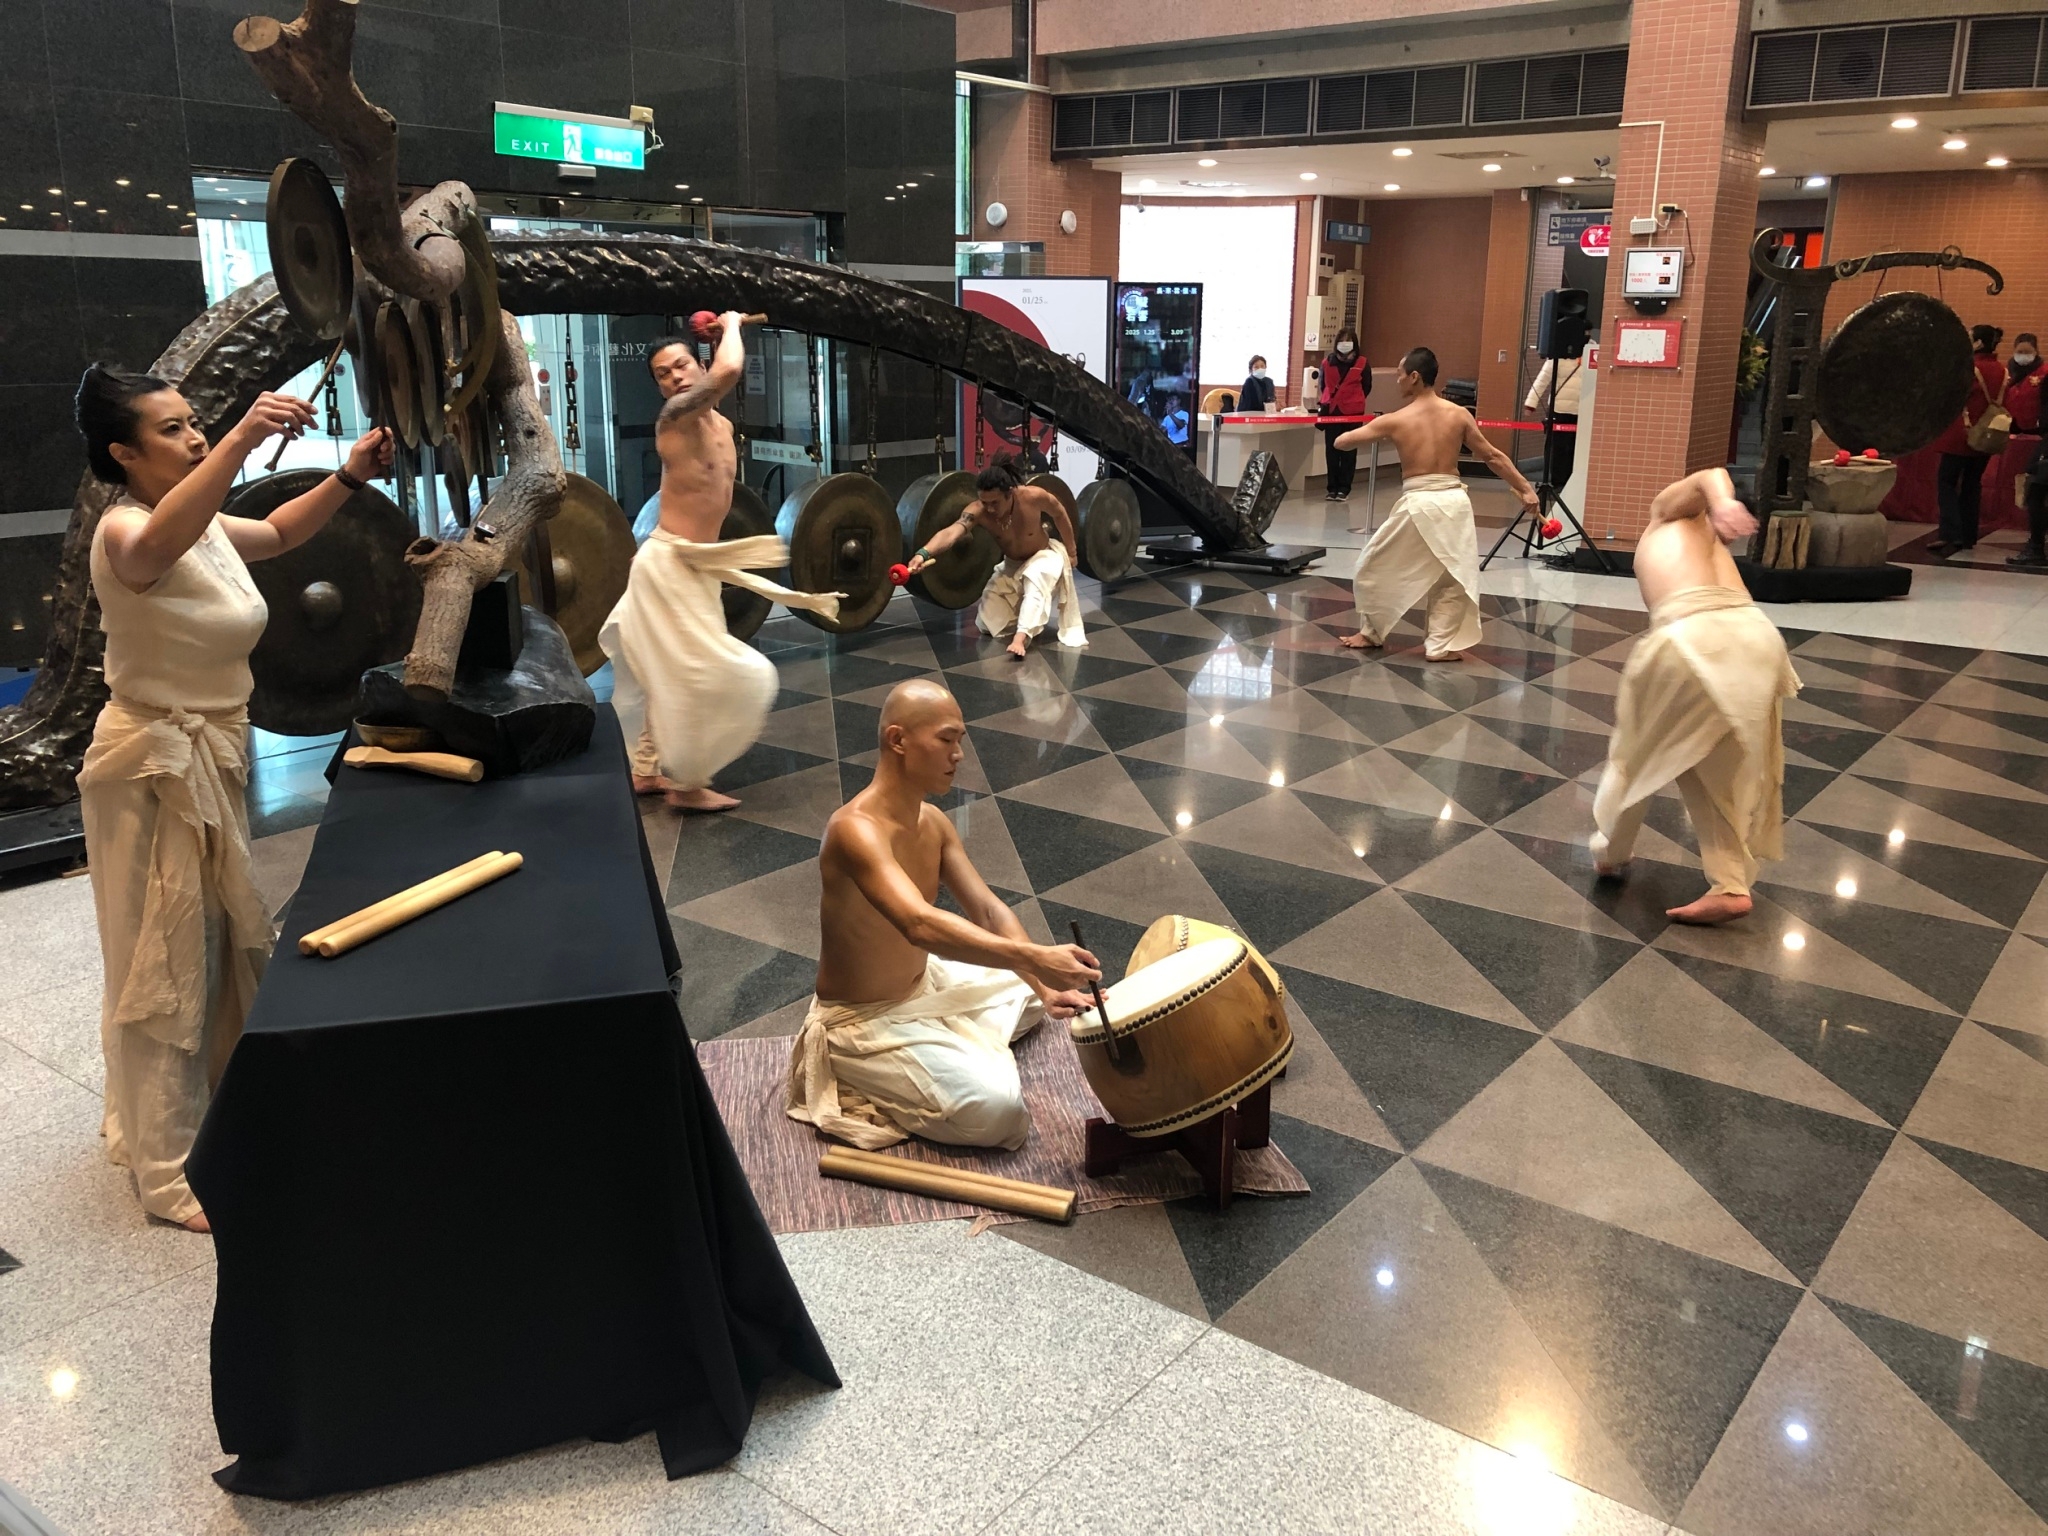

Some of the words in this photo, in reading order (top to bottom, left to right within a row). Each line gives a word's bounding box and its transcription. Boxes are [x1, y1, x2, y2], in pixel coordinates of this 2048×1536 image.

[511, 138, 550, 153] EXIT
[1022, 296, 1043, 304] 01/25
[1066, 445, 1086, 453] 03/09
